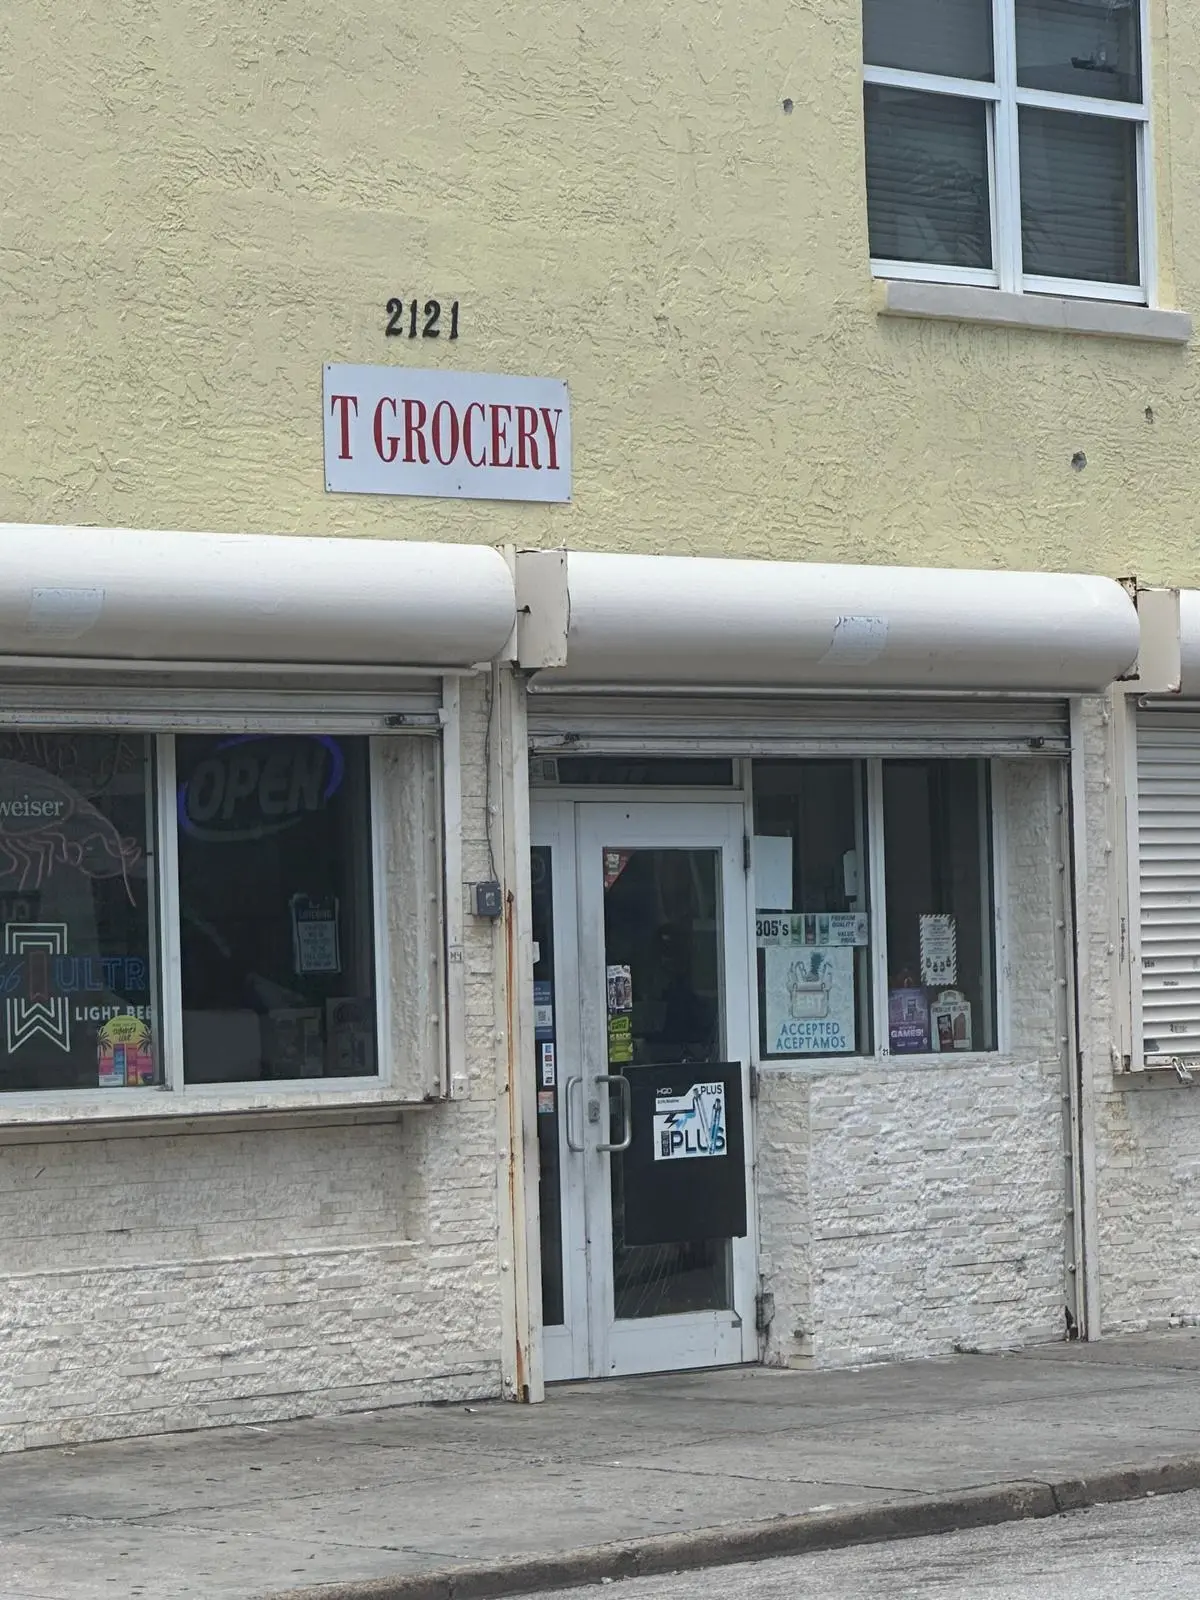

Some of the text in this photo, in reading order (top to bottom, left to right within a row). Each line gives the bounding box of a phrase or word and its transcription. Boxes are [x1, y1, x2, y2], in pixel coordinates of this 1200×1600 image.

[386, 298, 459, 339] 2121
[331, 395, 562, 470] T GROCERY
[189, 750, 325, 820] OPEN
[756, 920, 789, 936] 305's
[75, 1005, 121, 1021] LIGHT
[780, 1022, 840, 1036] ACCEPTED
[890, 1028, 925, 1038] GAMES!
[776, 1036, 847, 1050] ACEPTAMOS
[700, 1084, 723, 1096] PLUS
[670, 1126, 726, 1154] PLUS
